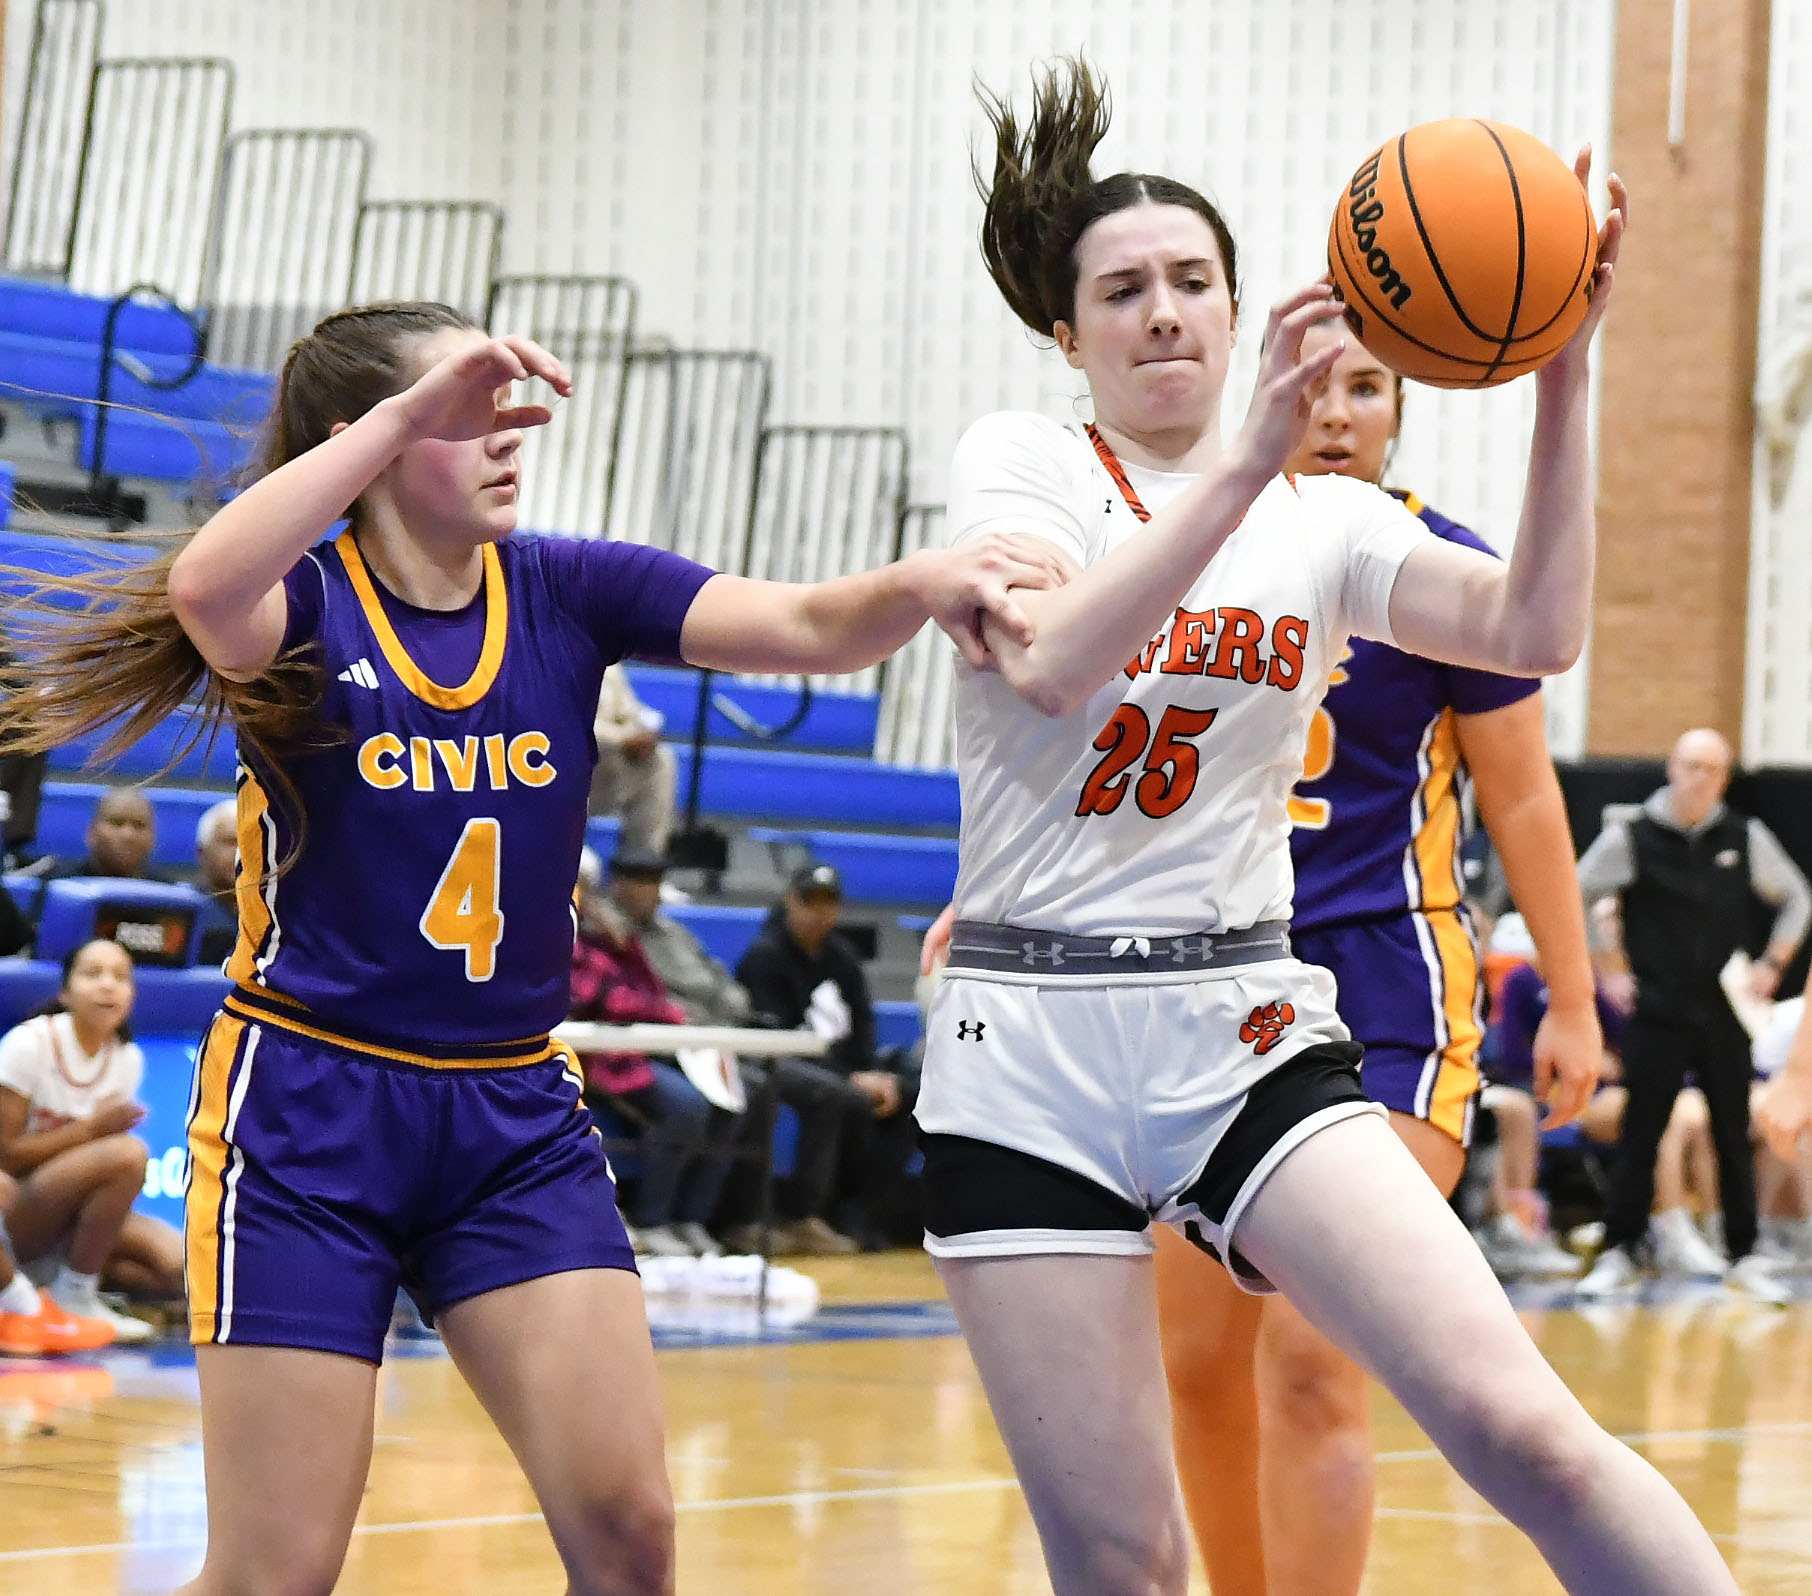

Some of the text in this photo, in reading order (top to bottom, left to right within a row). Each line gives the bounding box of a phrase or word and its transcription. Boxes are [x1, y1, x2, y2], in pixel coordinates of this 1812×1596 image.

[1349, 148, 1412, 312] Wilson
[357, 730, 558, 792] CIVIC
[1074, 703, 1219, 819] 25
[418, 816, 505, 983] 4
